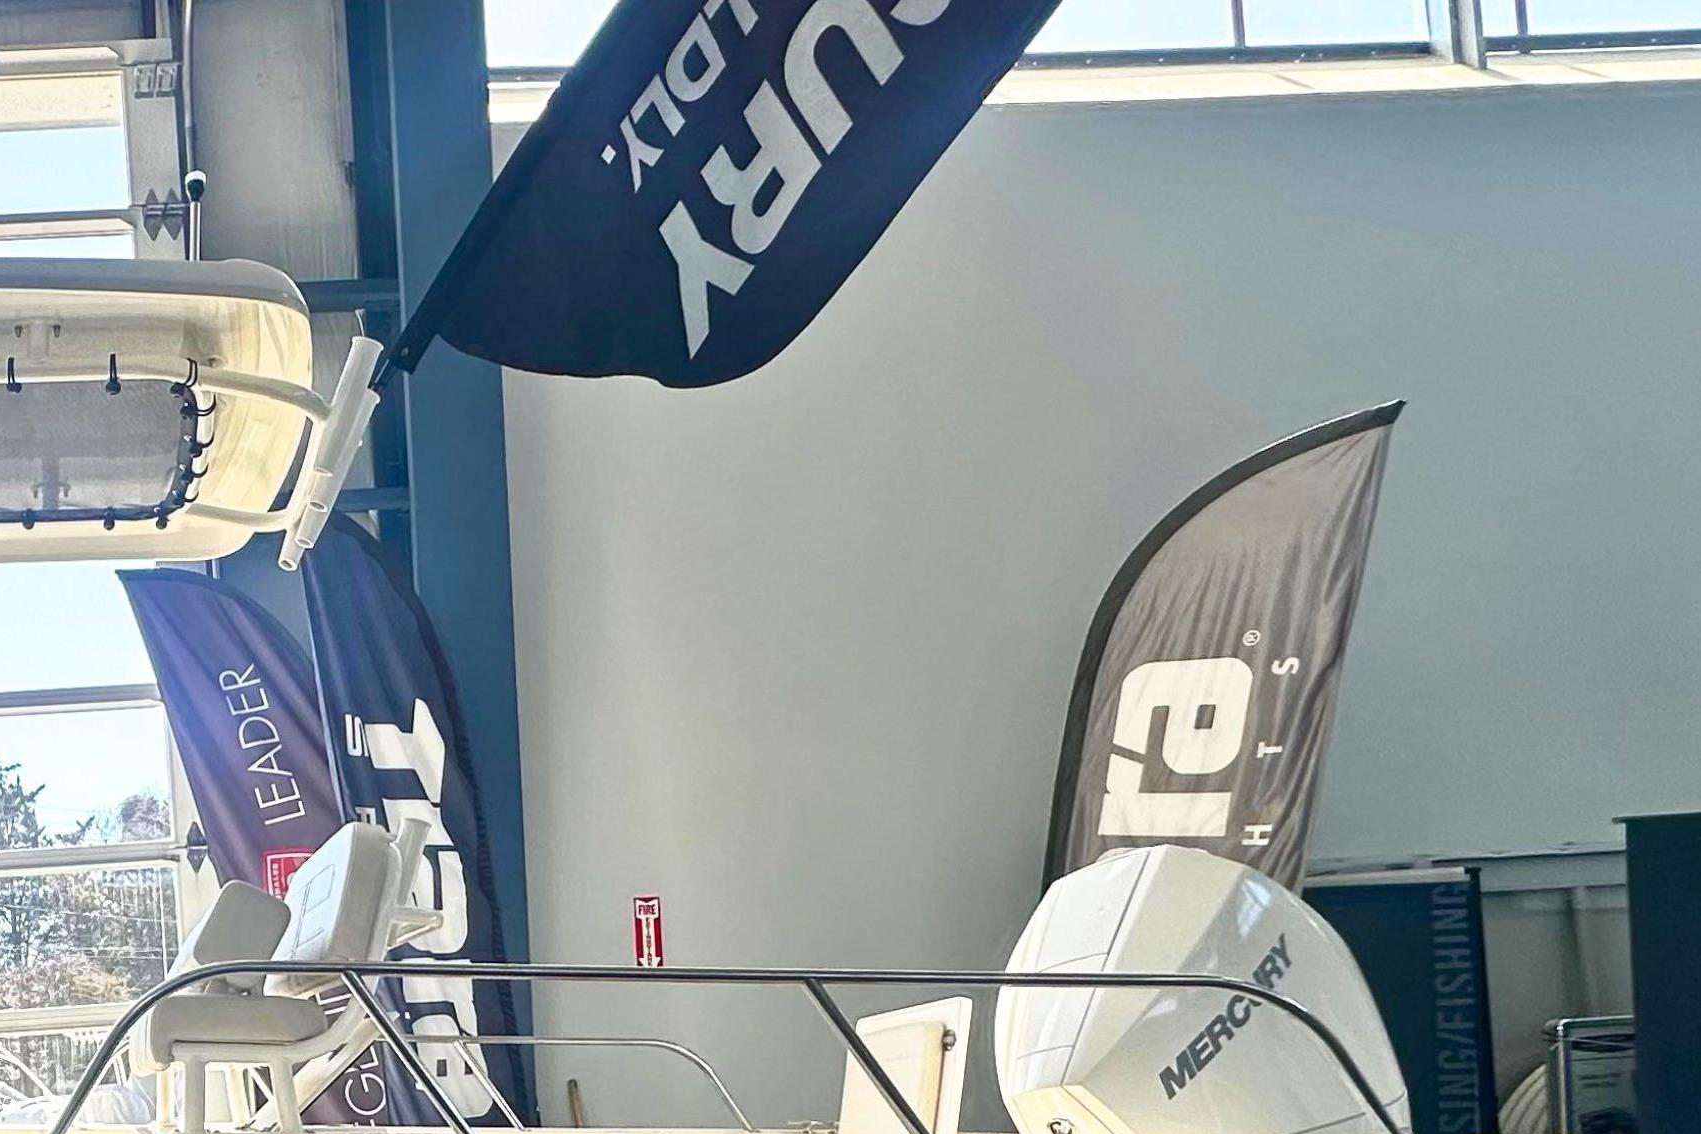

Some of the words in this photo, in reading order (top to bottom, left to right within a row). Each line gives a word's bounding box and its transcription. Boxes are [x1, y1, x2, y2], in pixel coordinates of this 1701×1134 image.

[659, 0, 949, 359] URY
[219, 663, 307, 826] LEADER
[638, 904, 656, 915] FIRE
